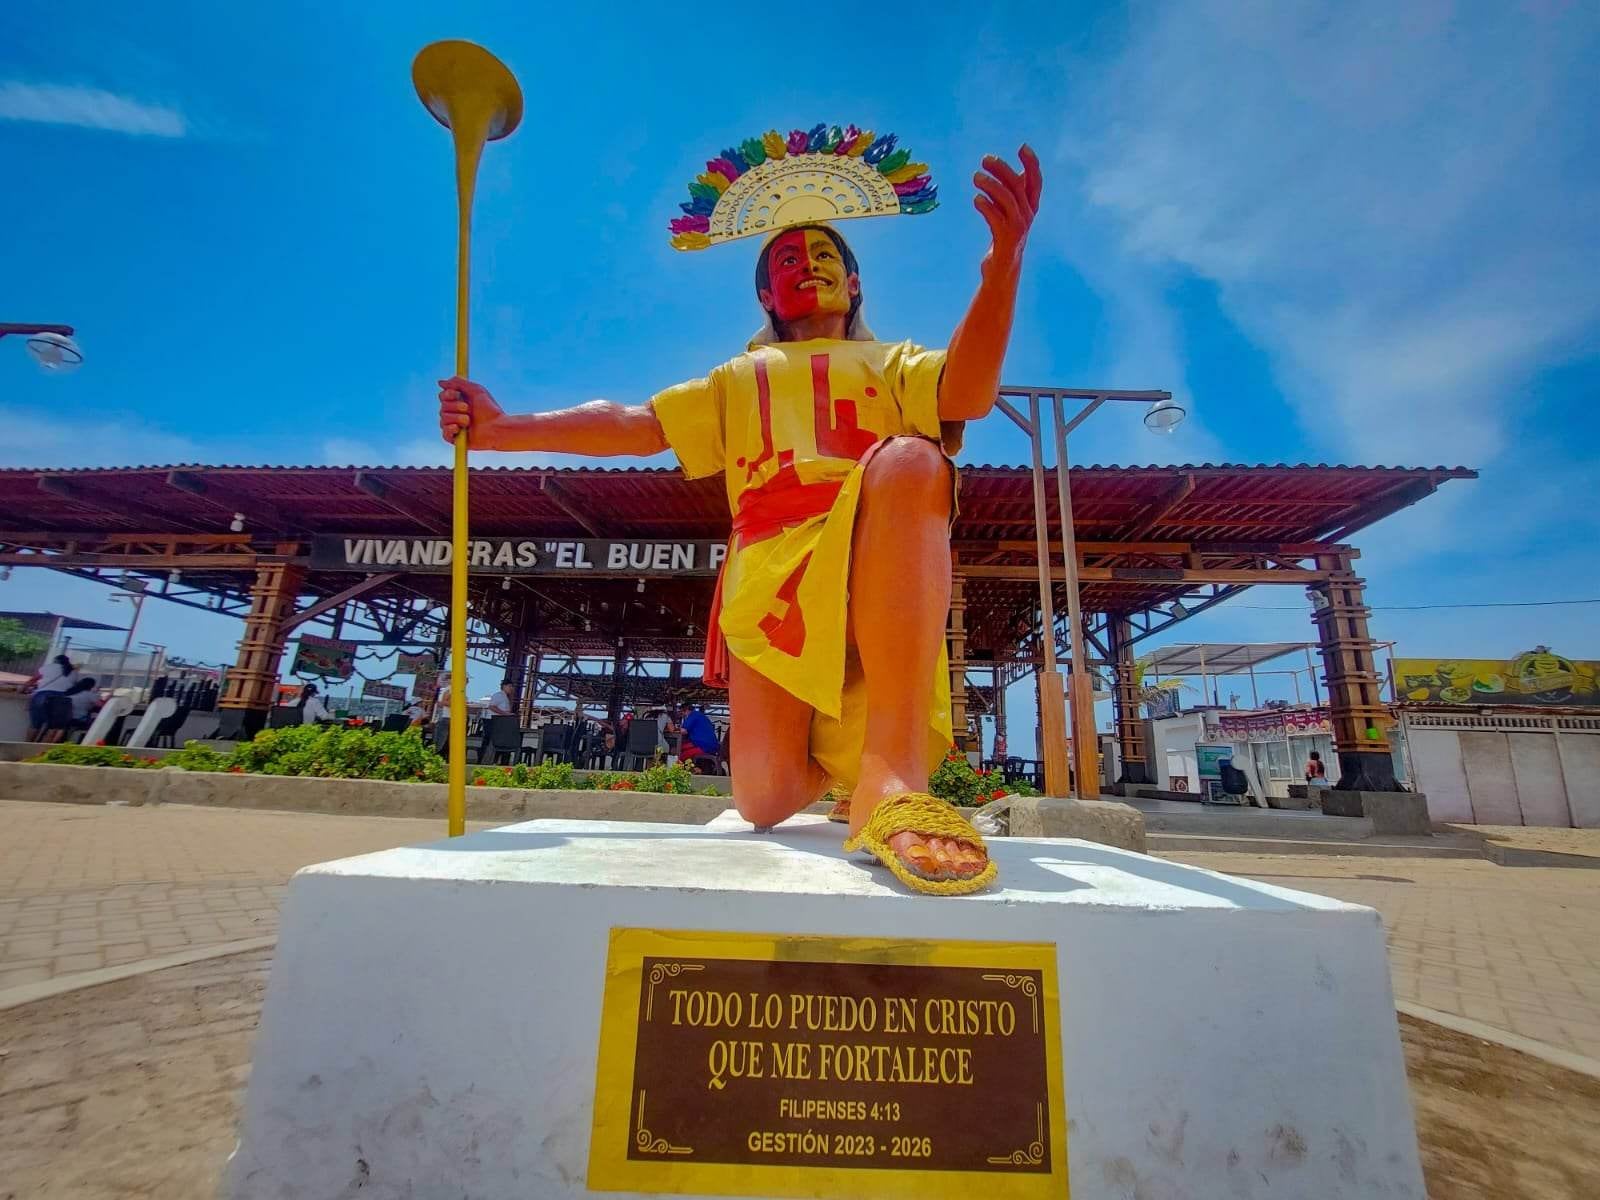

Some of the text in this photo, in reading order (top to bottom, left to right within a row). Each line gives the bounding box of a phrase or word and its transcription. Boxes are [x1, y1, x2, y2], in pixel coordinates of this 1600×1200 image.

[543, 541, 593, 569] "EL
[606, 543, 695, 569] BUEN
[669, 990, 1016, 1036] TODO LO PUEDO EN CRISTO
[708, 1040, 974, 1089] QUE ME FORTALECE
[780, 1099, 901, 1122] FILIPENSES 4:13
[747, 1129, 829, 1154] GESTIÓN
[834, 1134, 875, 1155] 2023
[891, 1136, 932, 1157] 2026
